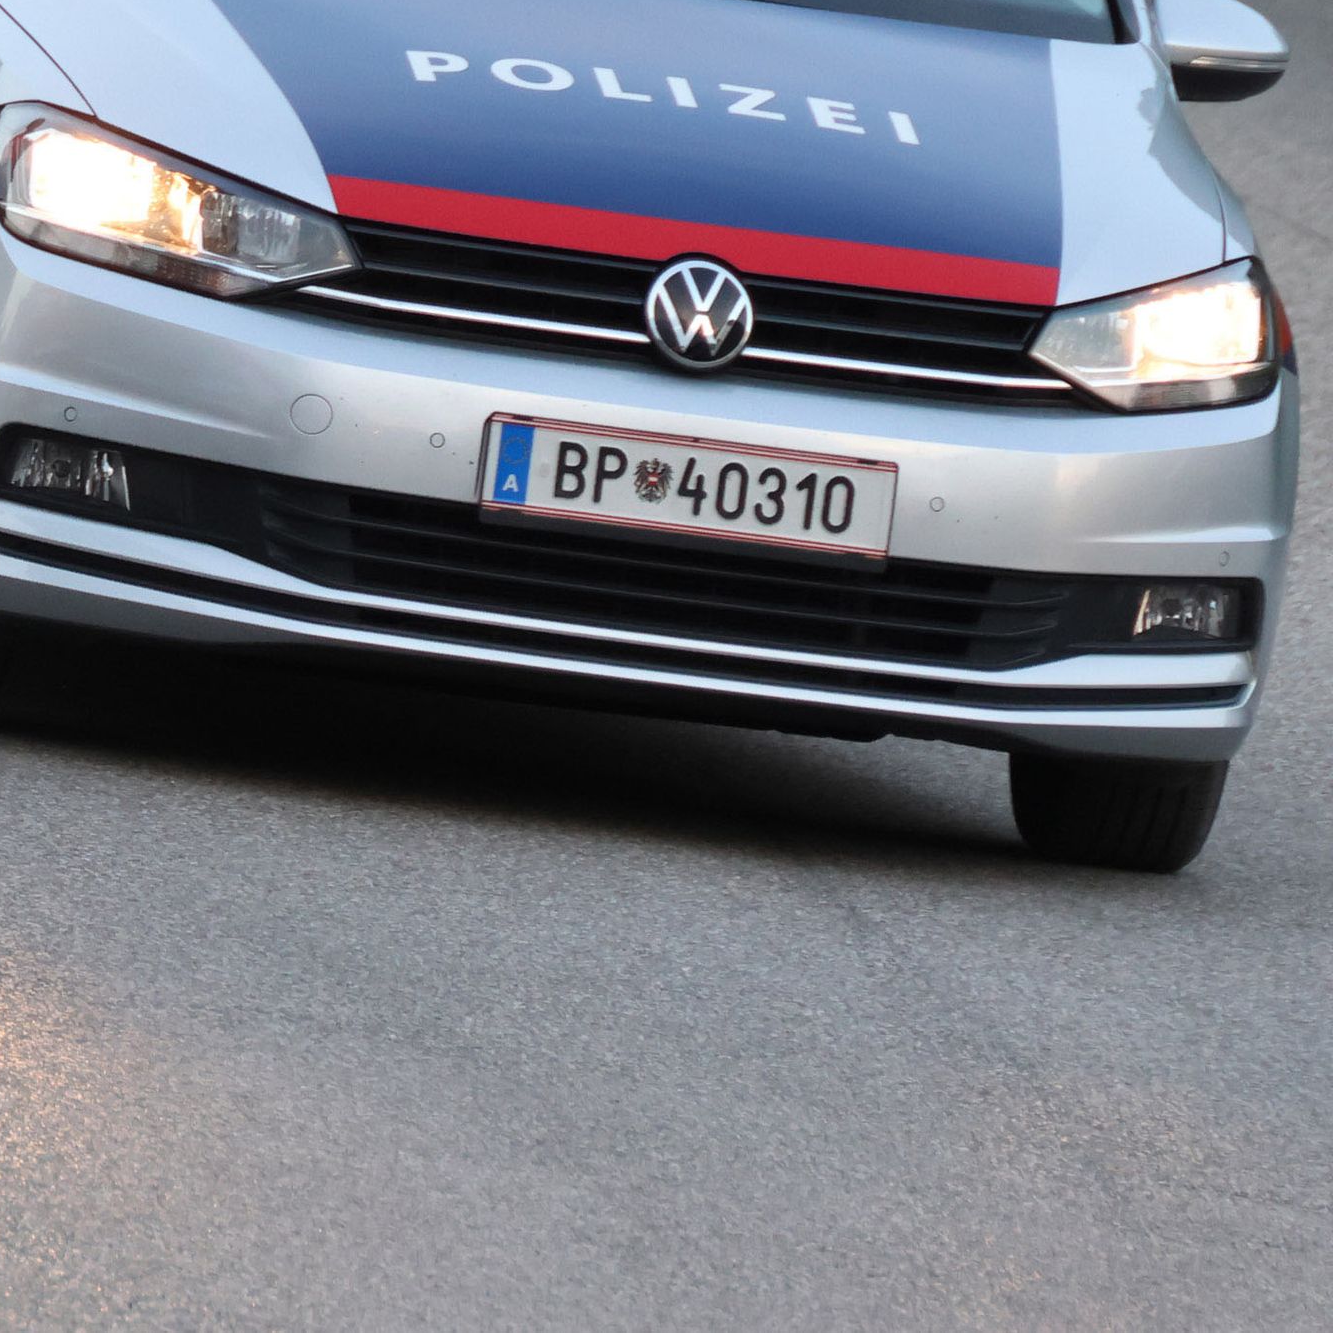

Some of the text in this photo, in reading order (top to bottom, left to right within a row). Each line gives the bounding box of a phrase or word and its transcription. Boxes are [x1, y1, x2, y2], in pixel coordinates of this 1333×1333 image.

[405, 49, 921, 146] POLIZEI
[501, 472, 520, 493] A
[552, 440, 857, 536] BP 40310
